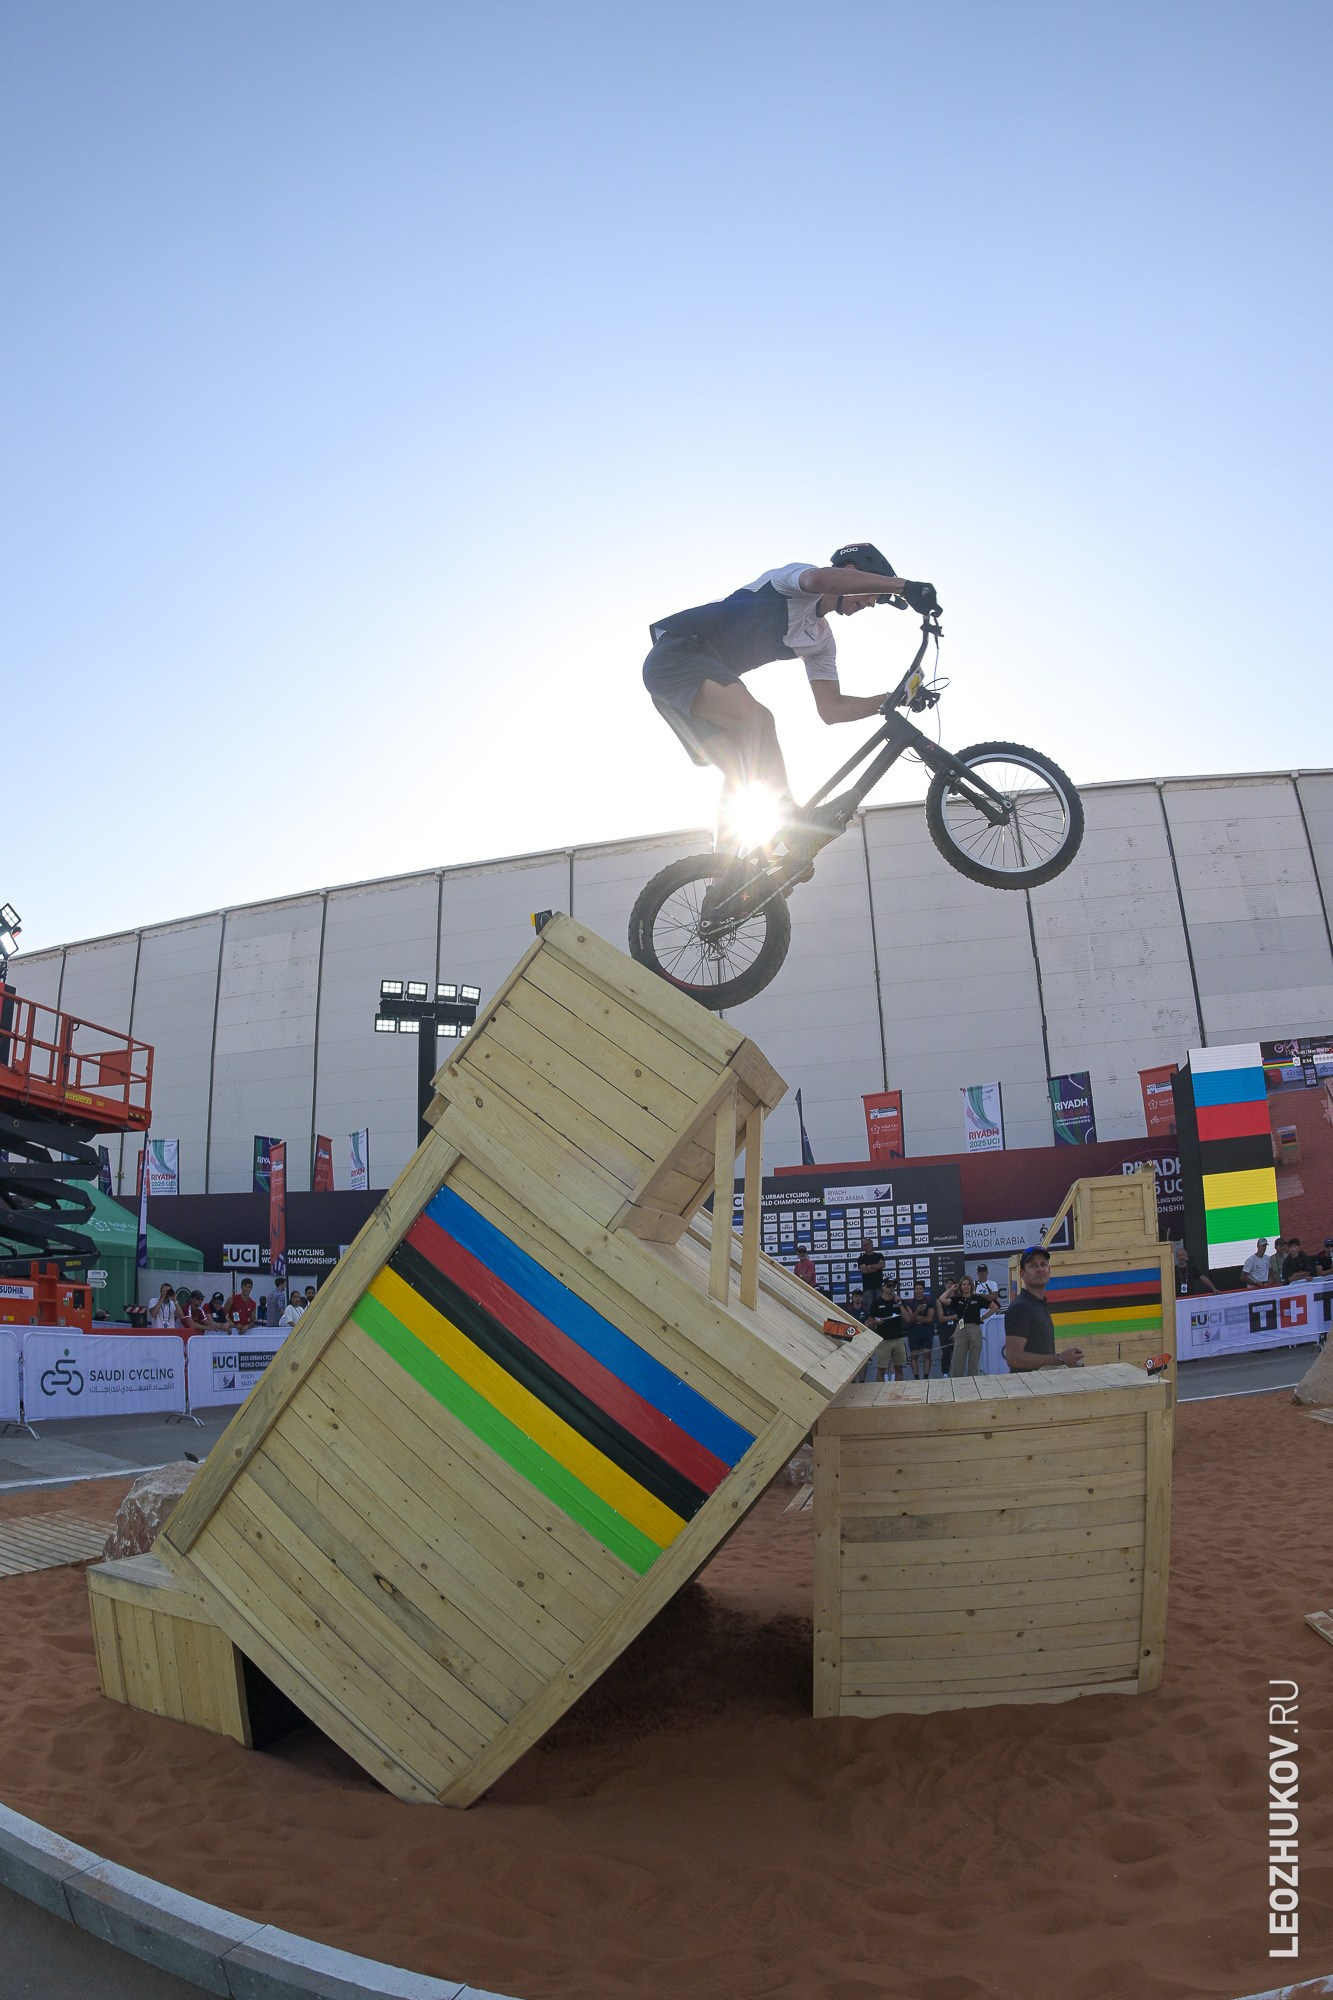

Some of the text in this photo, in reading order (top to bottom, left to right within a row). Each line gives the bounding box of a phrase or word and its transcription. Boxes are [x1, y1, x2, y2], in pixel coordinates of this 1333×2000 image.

[1054, 1097, 1089, 1111] RIYADH
[968, 1128, 1000, 1140] RIYADH
[970, 1138, 1000, 1148] 2025 UCI
[257, 1156, 270, 1164] RIYA
[774, 1197, 821, 1205] CHAMPIONSHIPS
[965, 1228, 997, 1238] RIYADH
[966, 1236, 1026, 1249] SAUDI ARABIA
[229, 1248, 256, 1263] UCI
[288, 1257, 337, 1265] HAMPIONSHIPS
[0, 1286, 24, 1295] SUDHIR
[217, 1355, 237, 1369] UCI
[89, 1368, 174, 1381] SAUDI CYCLING
